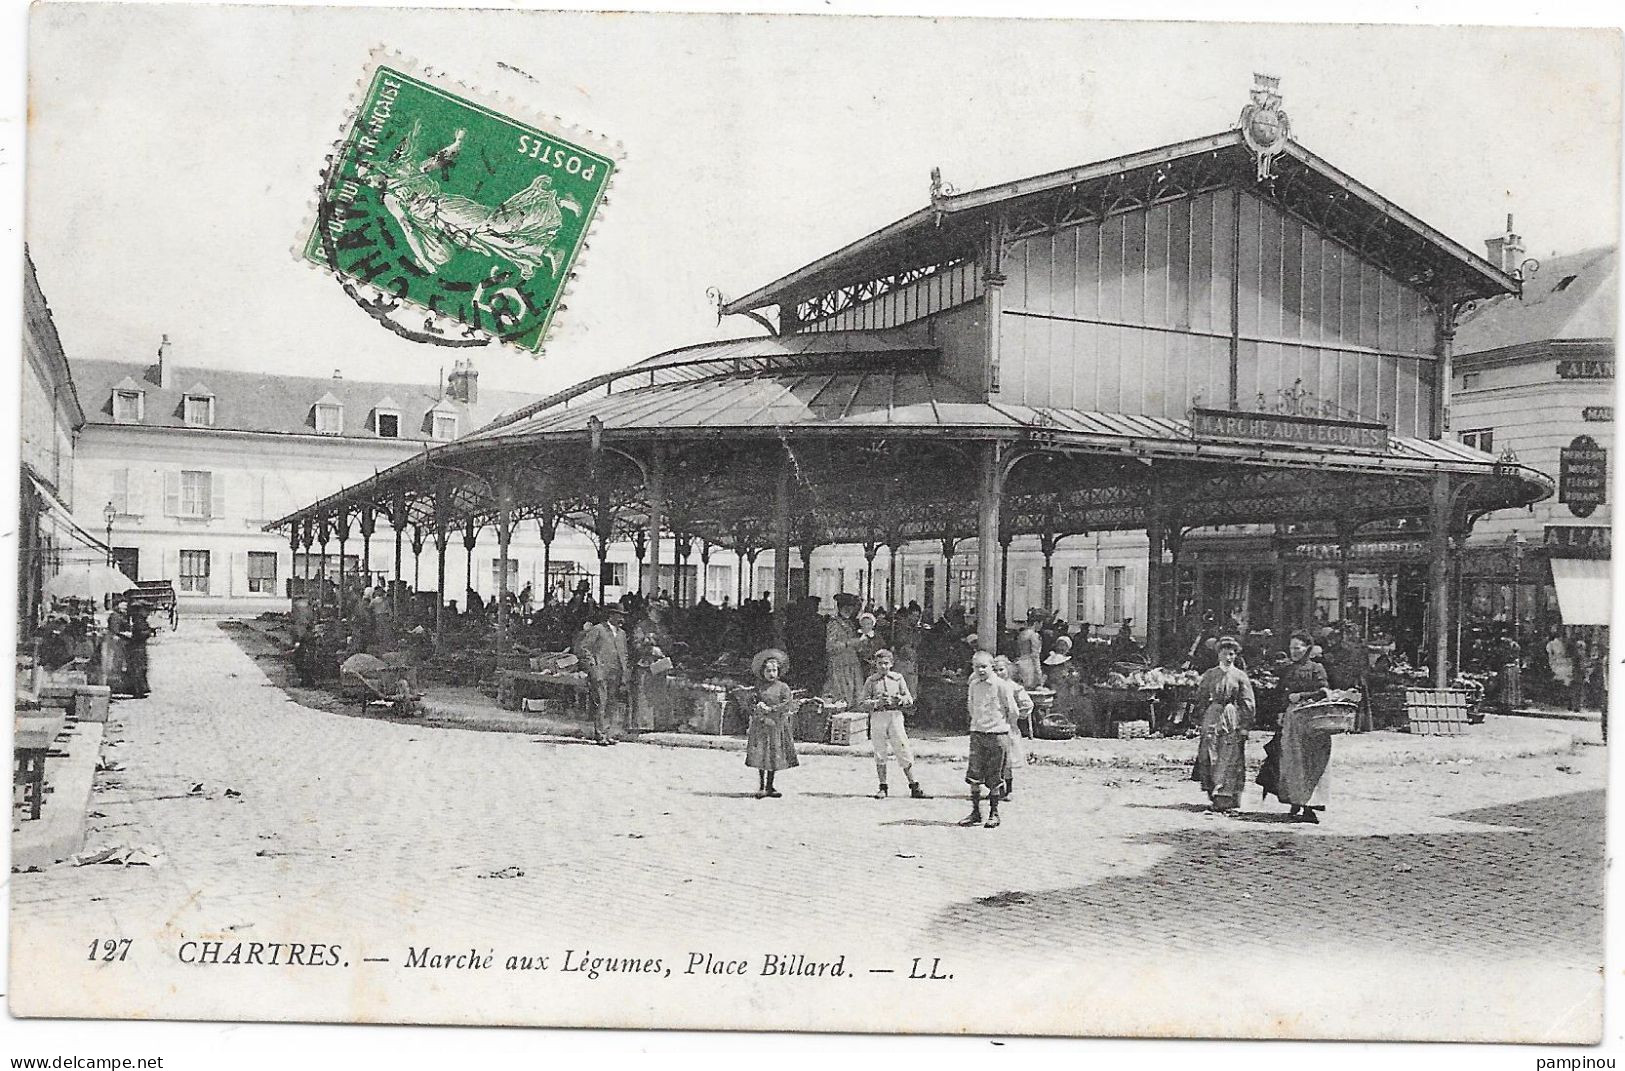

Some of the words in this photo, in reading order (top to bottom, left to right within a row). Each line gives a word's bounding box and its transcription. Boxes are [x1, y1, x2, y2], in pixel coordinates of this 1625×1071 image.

[517, 134, 597, 182] POSTES
[1201, 415, 1269, 437] MARCHE
[1273, 422, 1303, 439] AUX
[1308, 426, 1379, 446] LEGUMES
